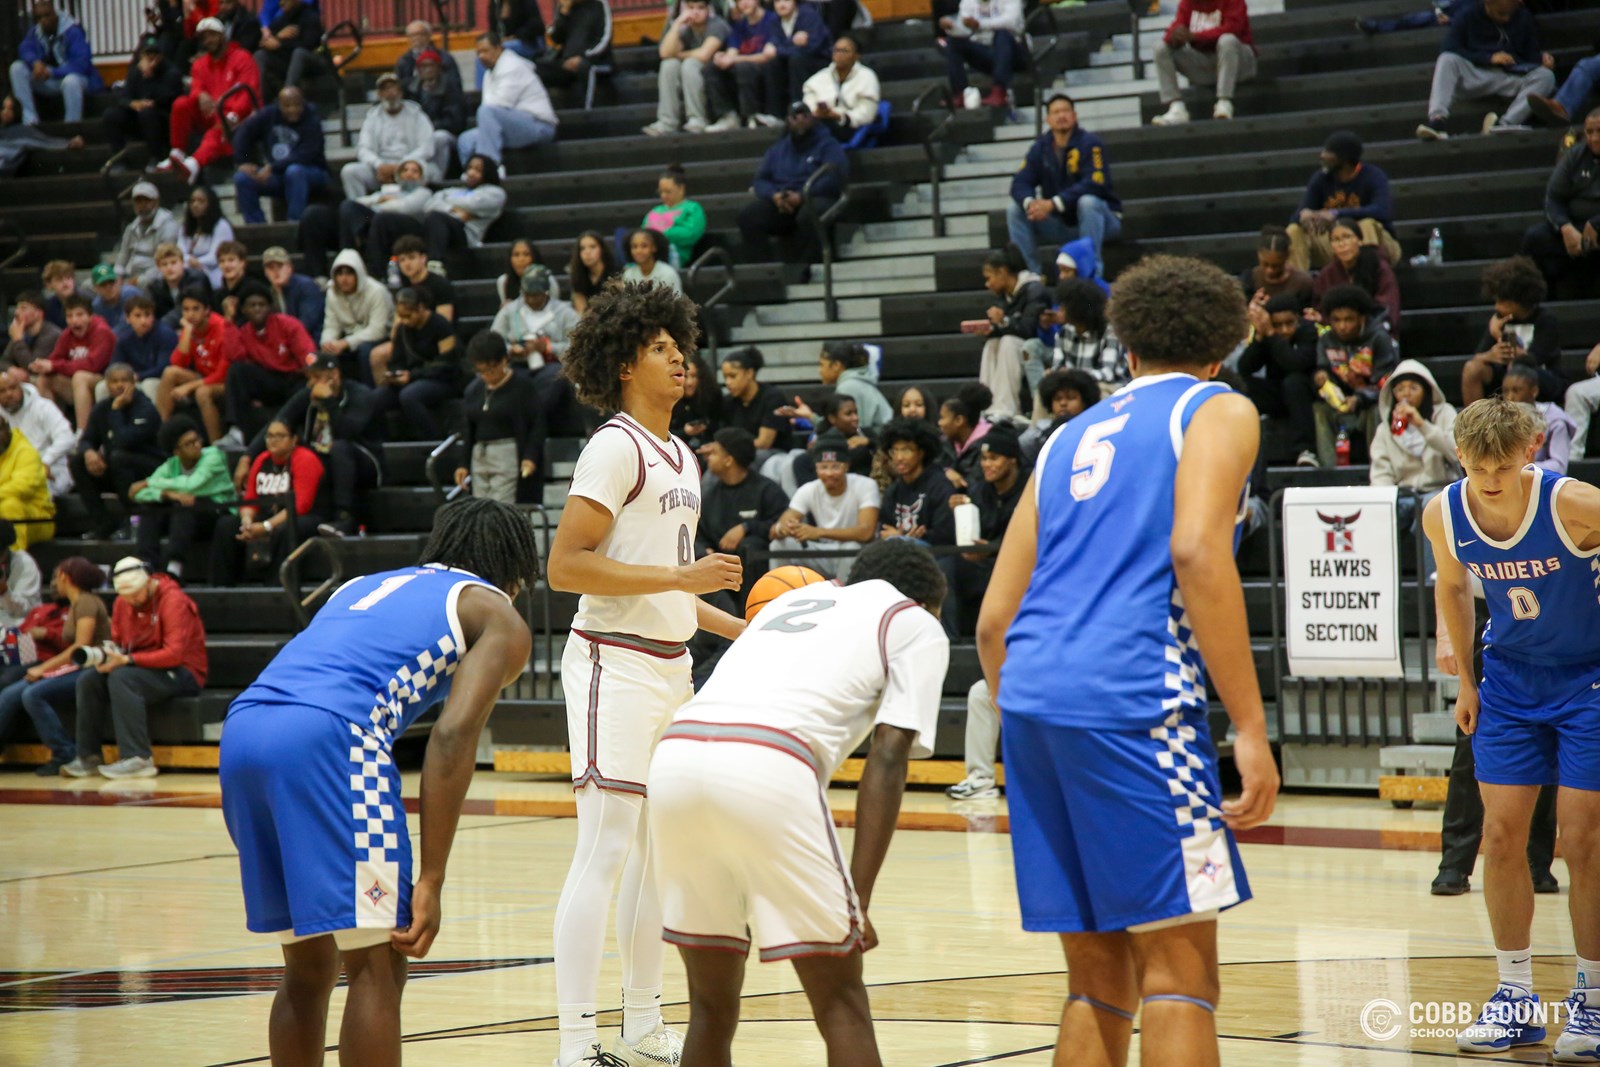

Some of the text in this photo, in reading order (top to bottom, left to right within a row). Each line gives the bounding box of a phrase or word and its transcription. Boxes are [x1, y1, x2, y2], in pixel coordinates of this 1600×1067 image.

[1069, 412, 1131, 502] 5
[659, 488, 681, 515] THE
[677, 523, 692, 567] 0
[1310, 559, 1371, 577] HAWKS
[1467, 557, 1562, 580] RAIDERS
[348, 574, 418, 611] 1
[1302, 591, 1381, 609] STUDENT
[1506, 586, 1541, 621] 0
[758, 598, 837, 633] 2
[1305, 624, 1378, 641] SECTION
